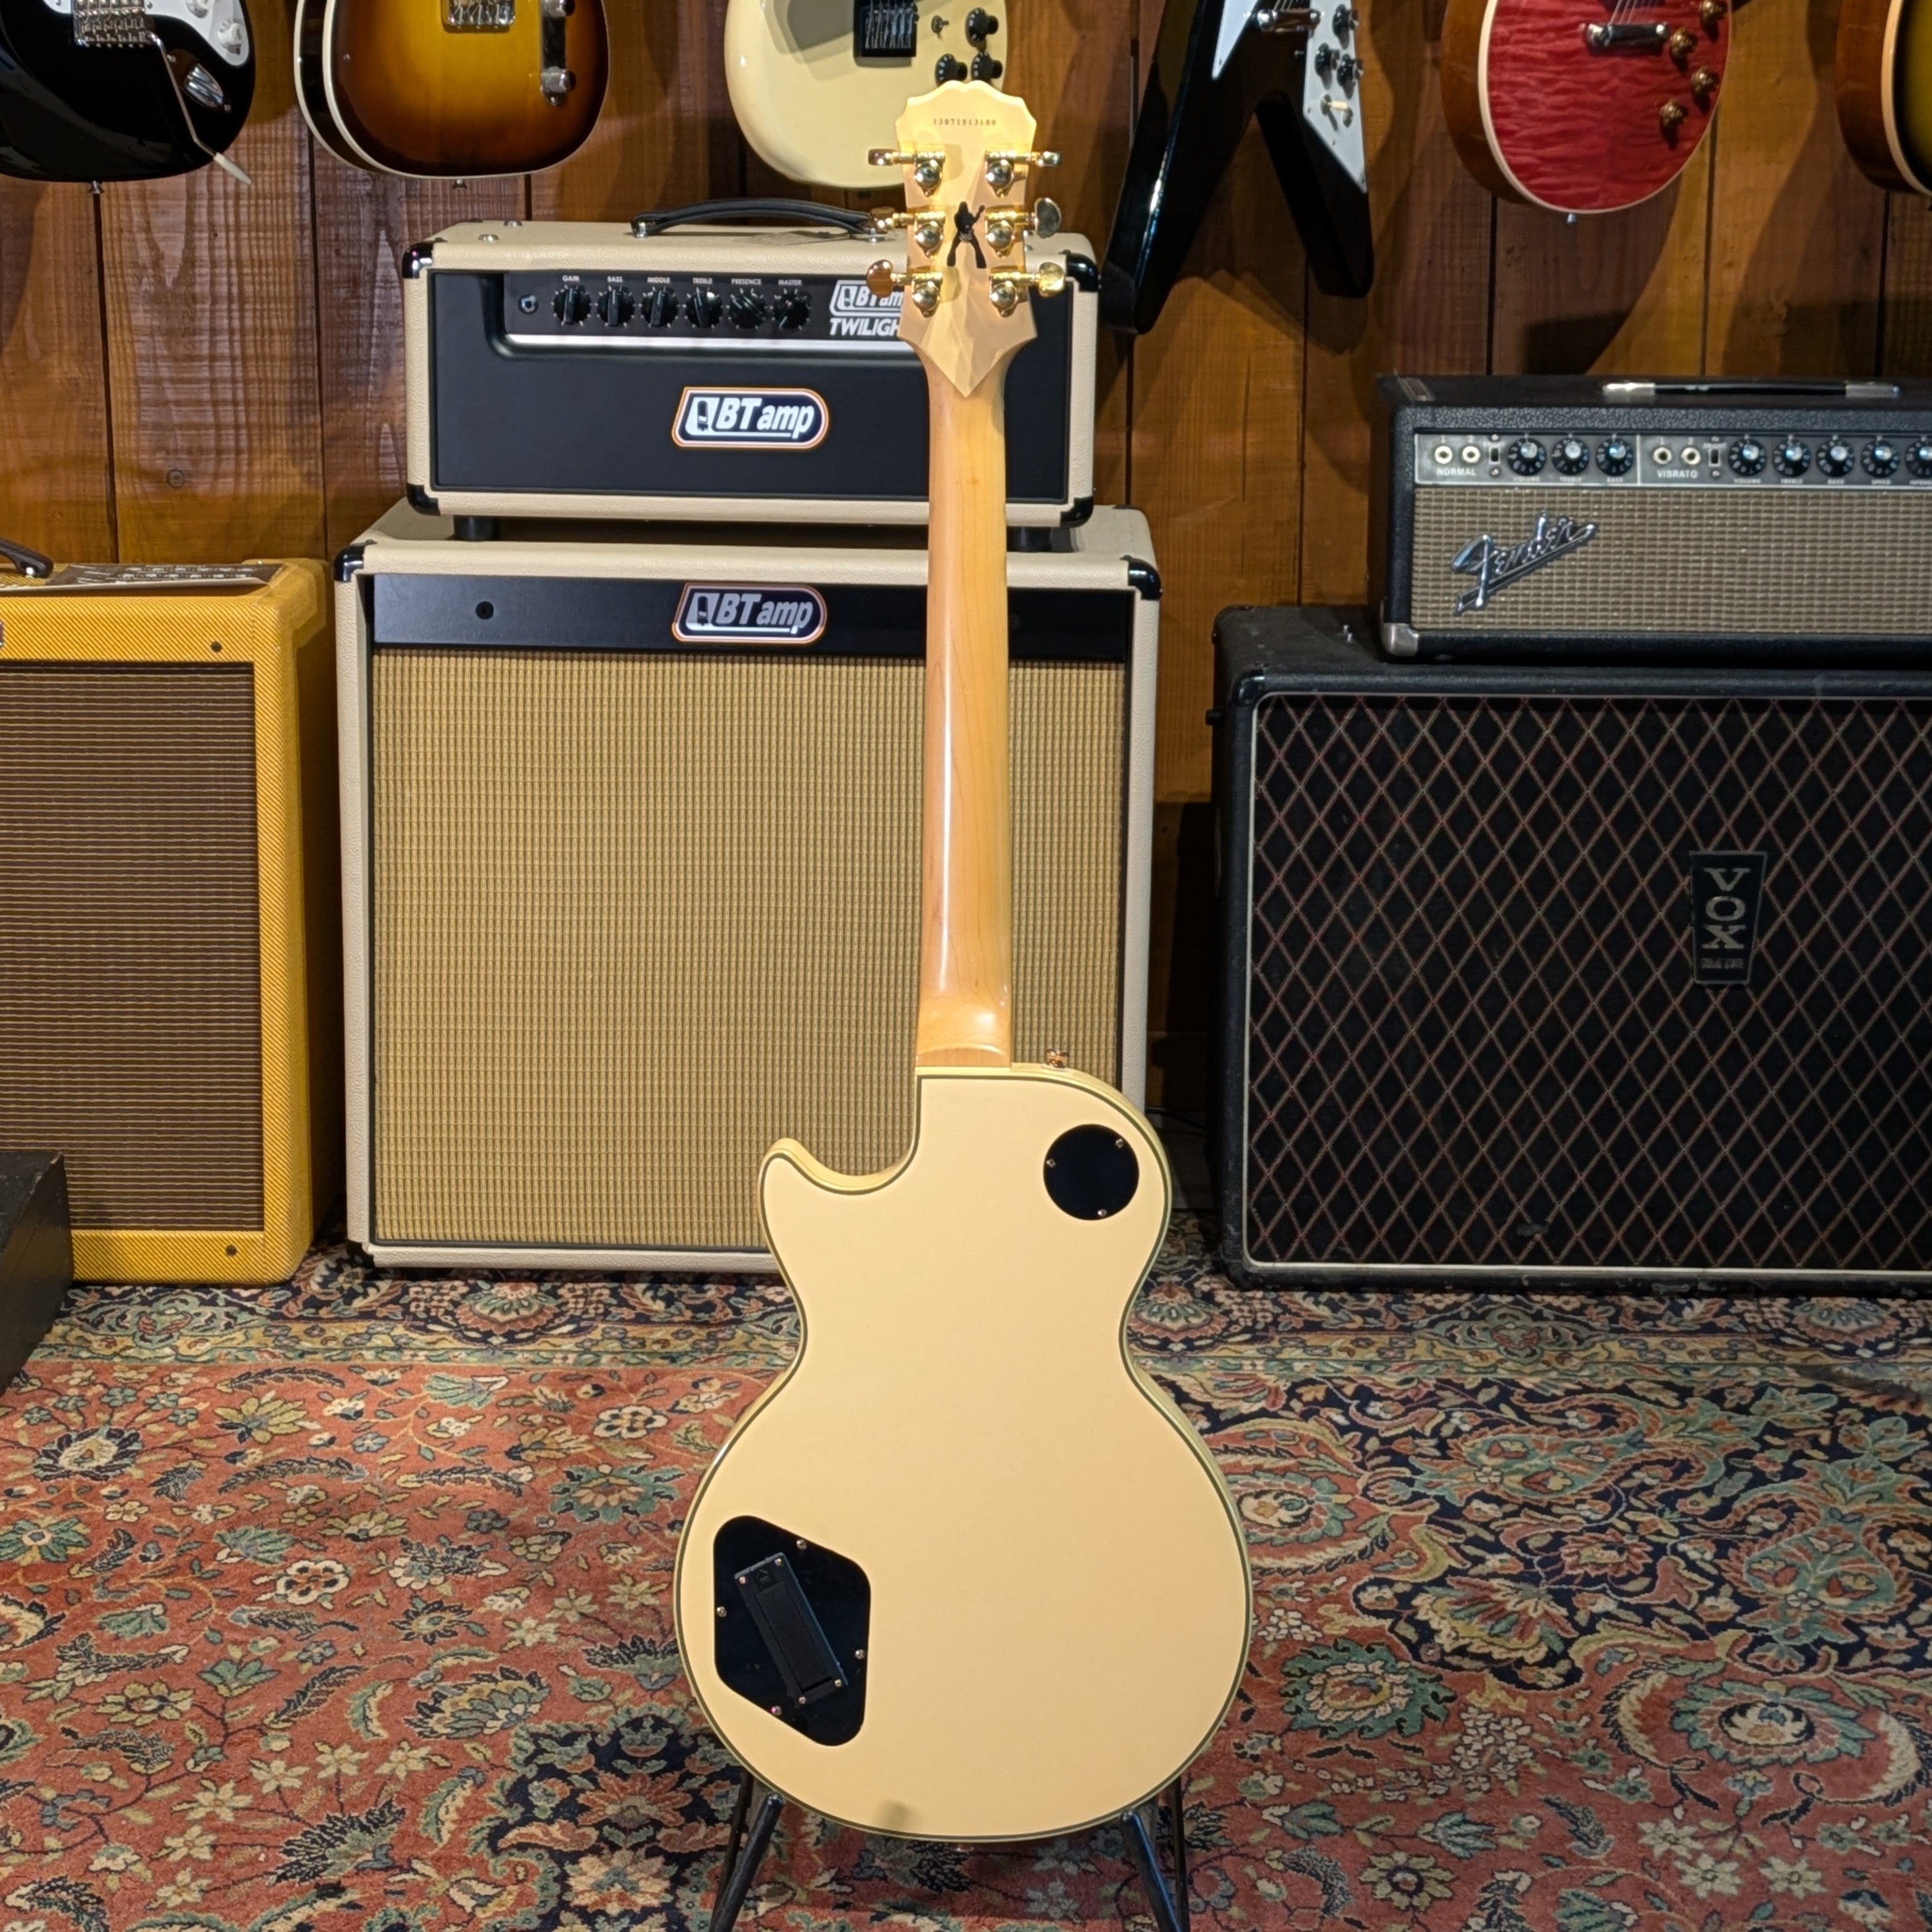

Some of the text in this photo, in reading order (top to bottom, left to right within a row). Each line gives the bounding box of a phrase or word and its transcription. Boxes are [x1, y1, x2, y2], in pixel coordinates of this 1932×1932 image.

[829, 318, 900, 336] TWILIGH
[1437, 467, 1477, 476] NORMAL
[1657, 469, 1698, 479] VIBRATO
[1452, 511, 1597, 617] Fender
[1701, 868, 1751, 949] VOX
